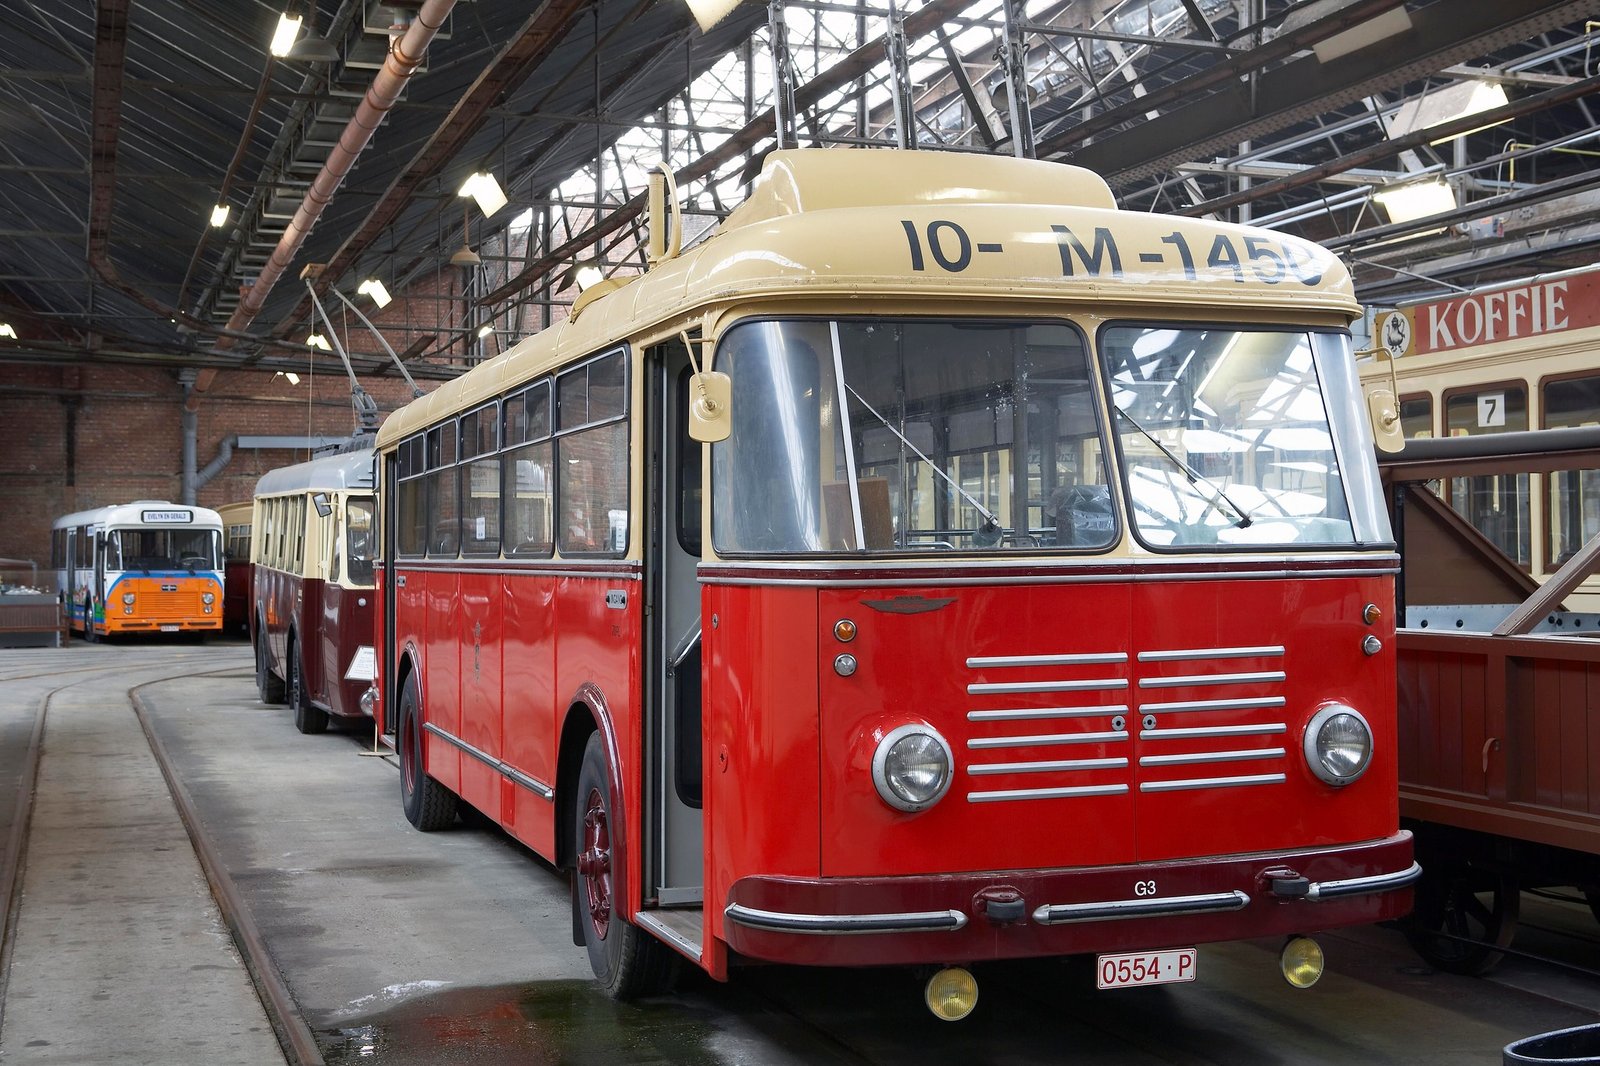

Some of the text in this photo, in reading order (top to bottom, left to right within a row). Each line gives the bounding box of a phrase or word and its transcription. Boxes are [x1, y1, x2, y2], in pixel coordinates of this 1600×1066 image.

[1428, 281, 1568, 350] KOFFIE
[1485, 399, 1496, 424] 7
[1134, 880, 1157, 896] G3
